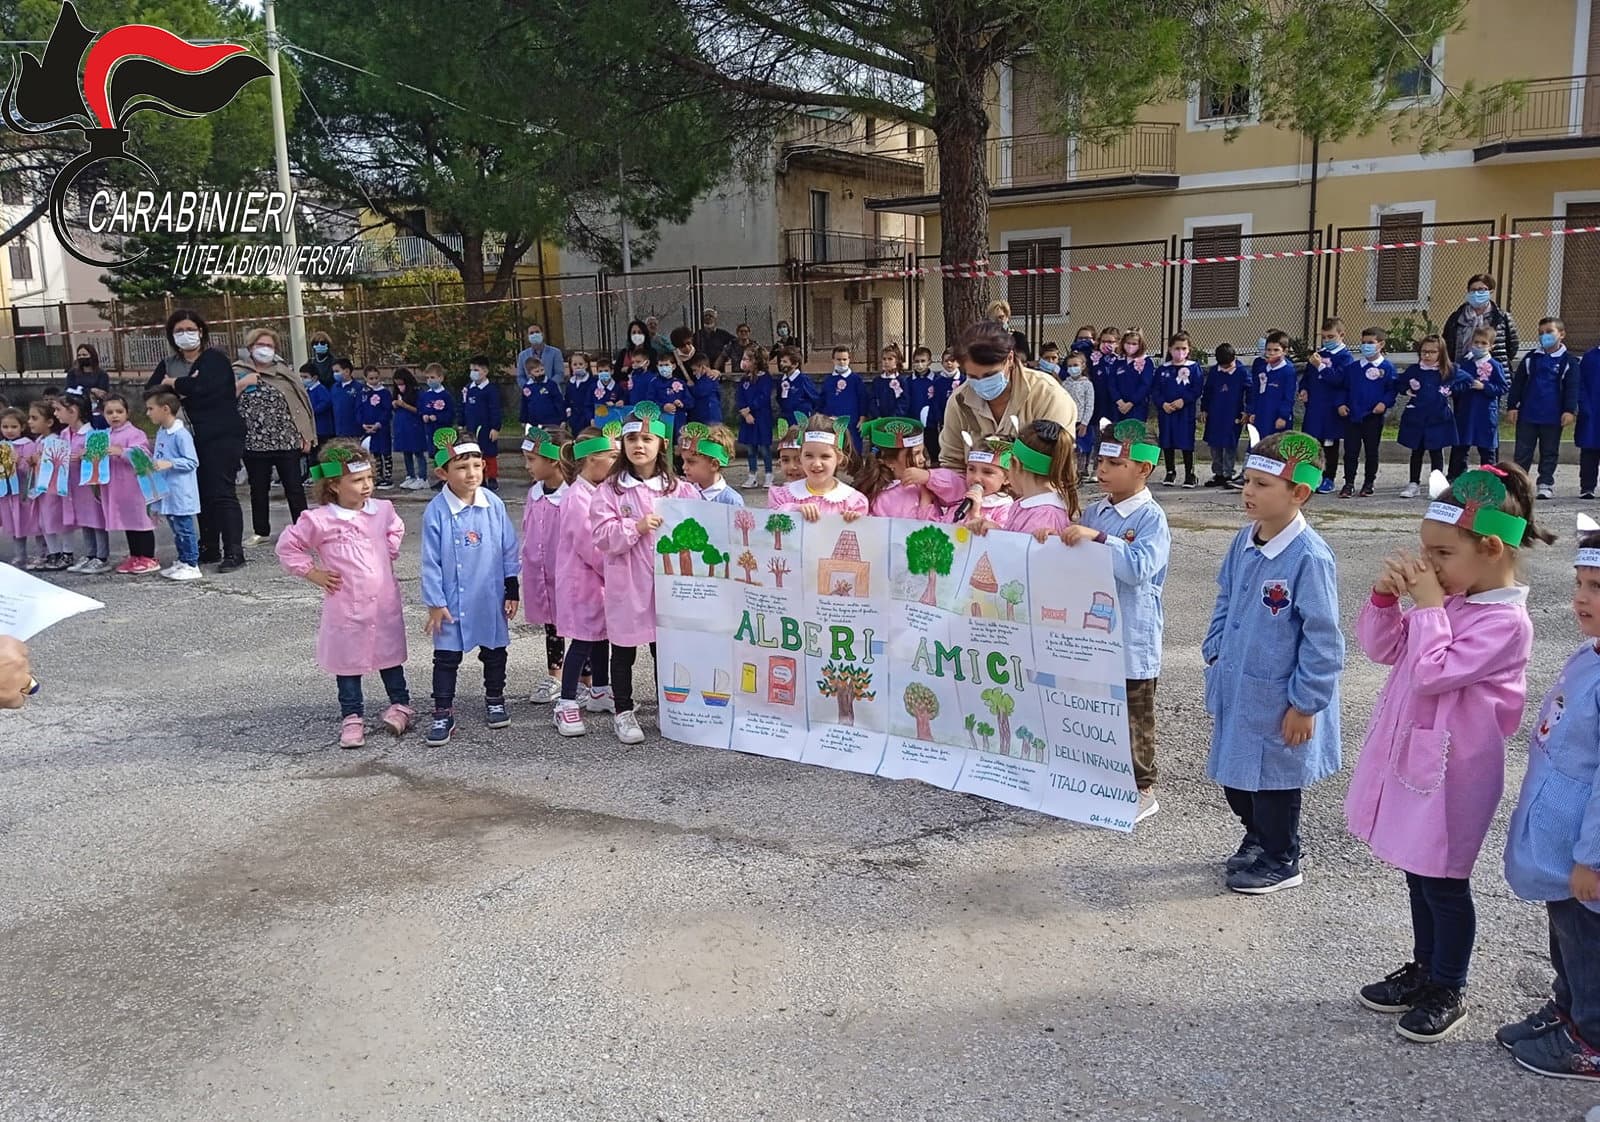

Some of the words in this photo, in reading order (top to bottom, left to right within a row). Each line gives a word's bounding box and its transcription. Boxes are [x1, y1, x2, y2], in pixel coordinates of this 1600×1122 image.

[734, 610, 875, 664] ALBERI
[911, 637, 1025, 691] AMICI
[1062, 717, 1117, 745] SCUOLA
[1090, 783, 1138, 804] CALVINO
